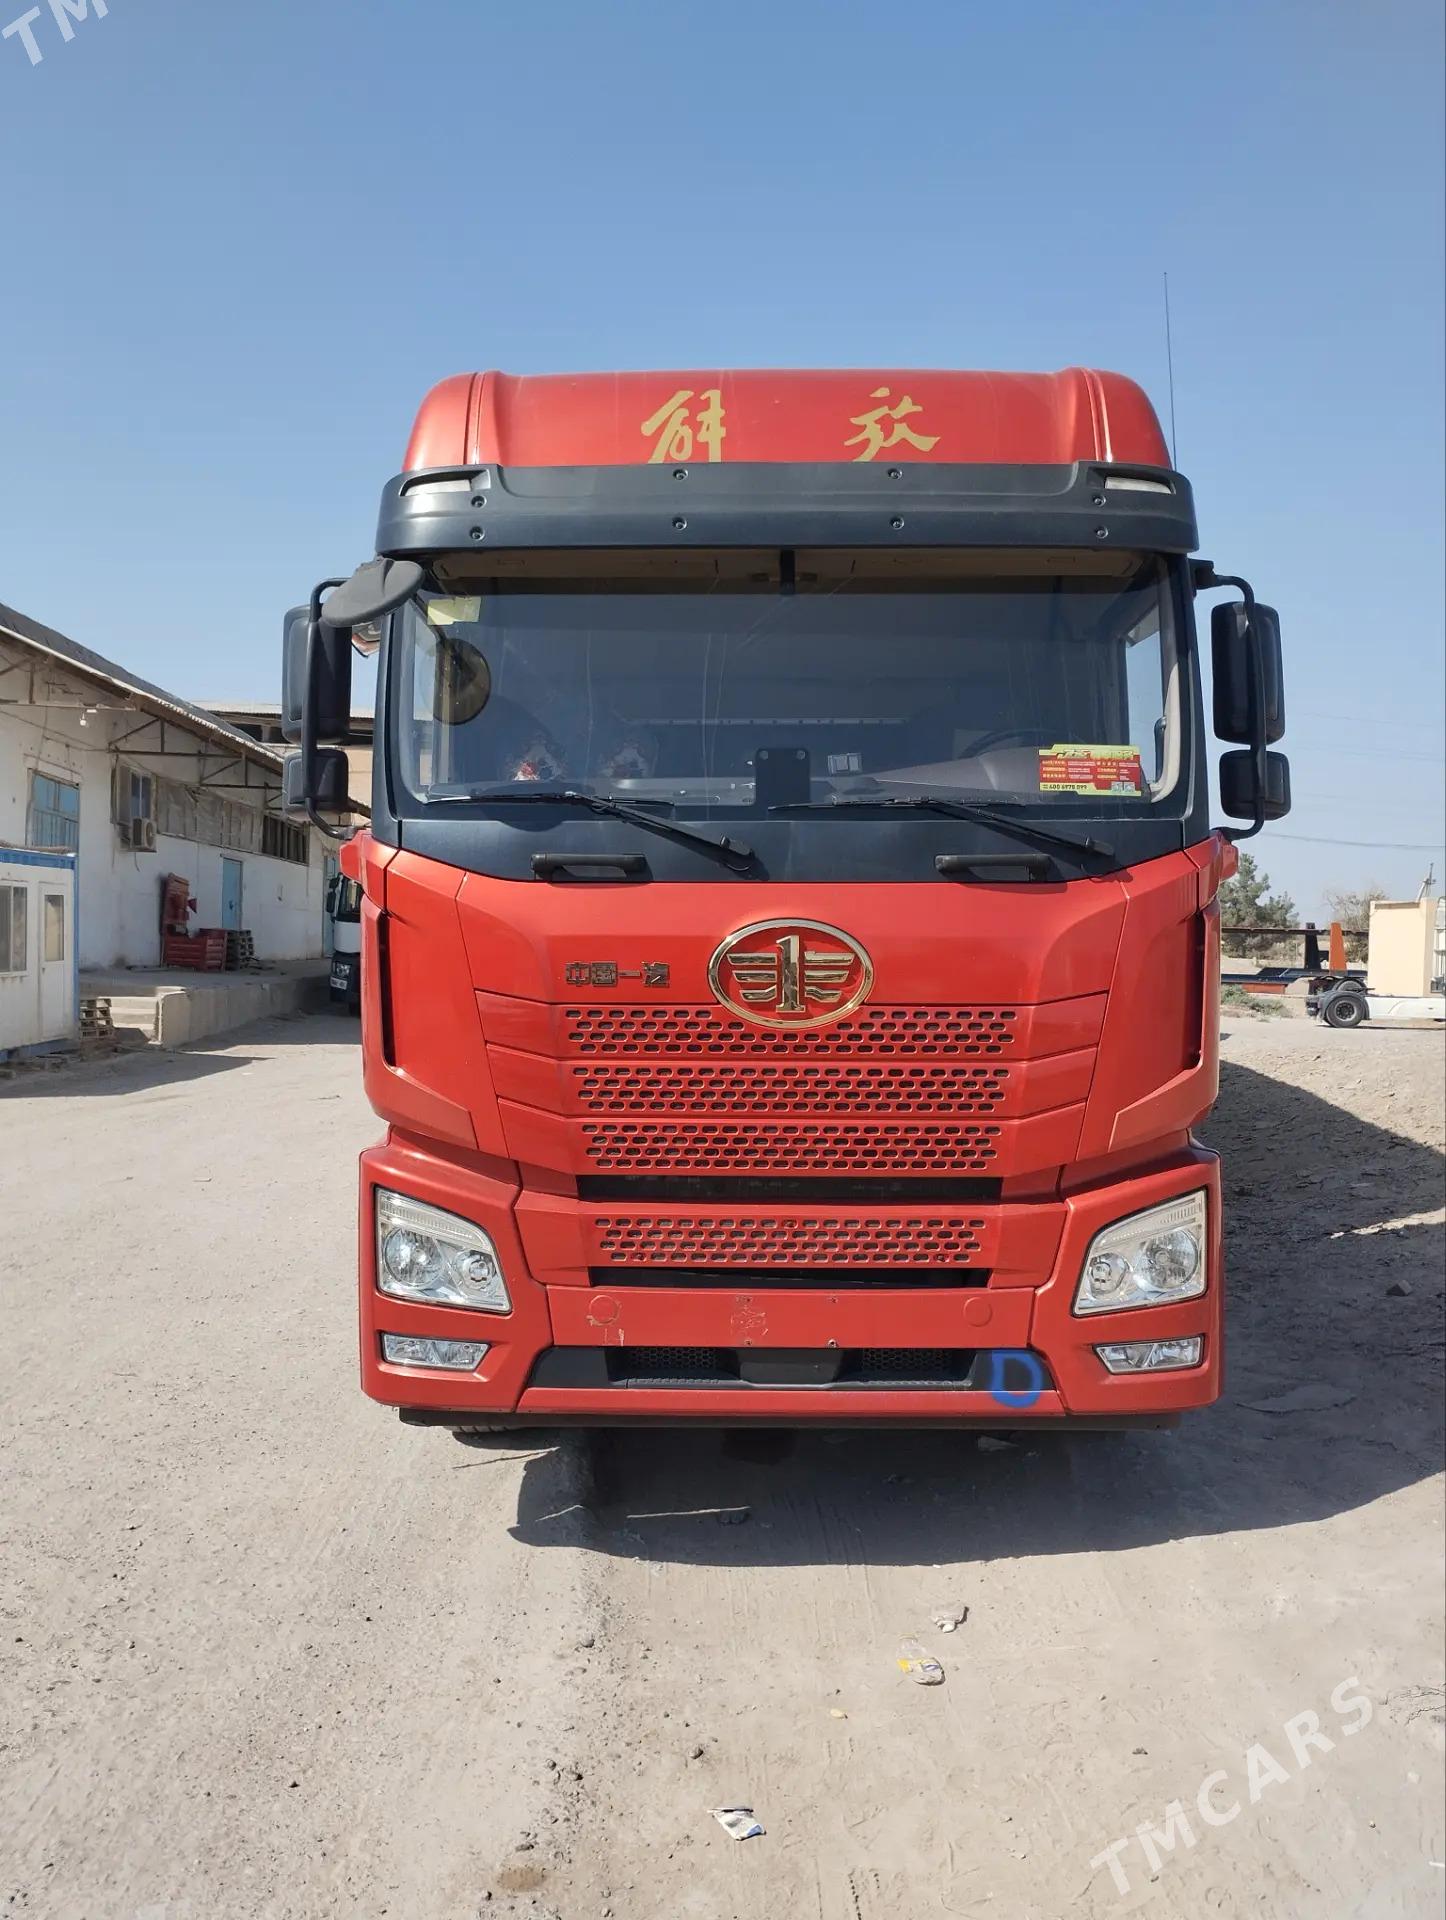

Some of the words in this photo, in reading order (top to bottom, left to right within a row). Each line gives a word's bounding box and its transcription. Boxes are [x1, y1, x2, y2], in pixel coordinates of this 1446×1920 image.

[566, 961, 670, 987] 中国一汽
[991, 1350, 1043, 1408] D
